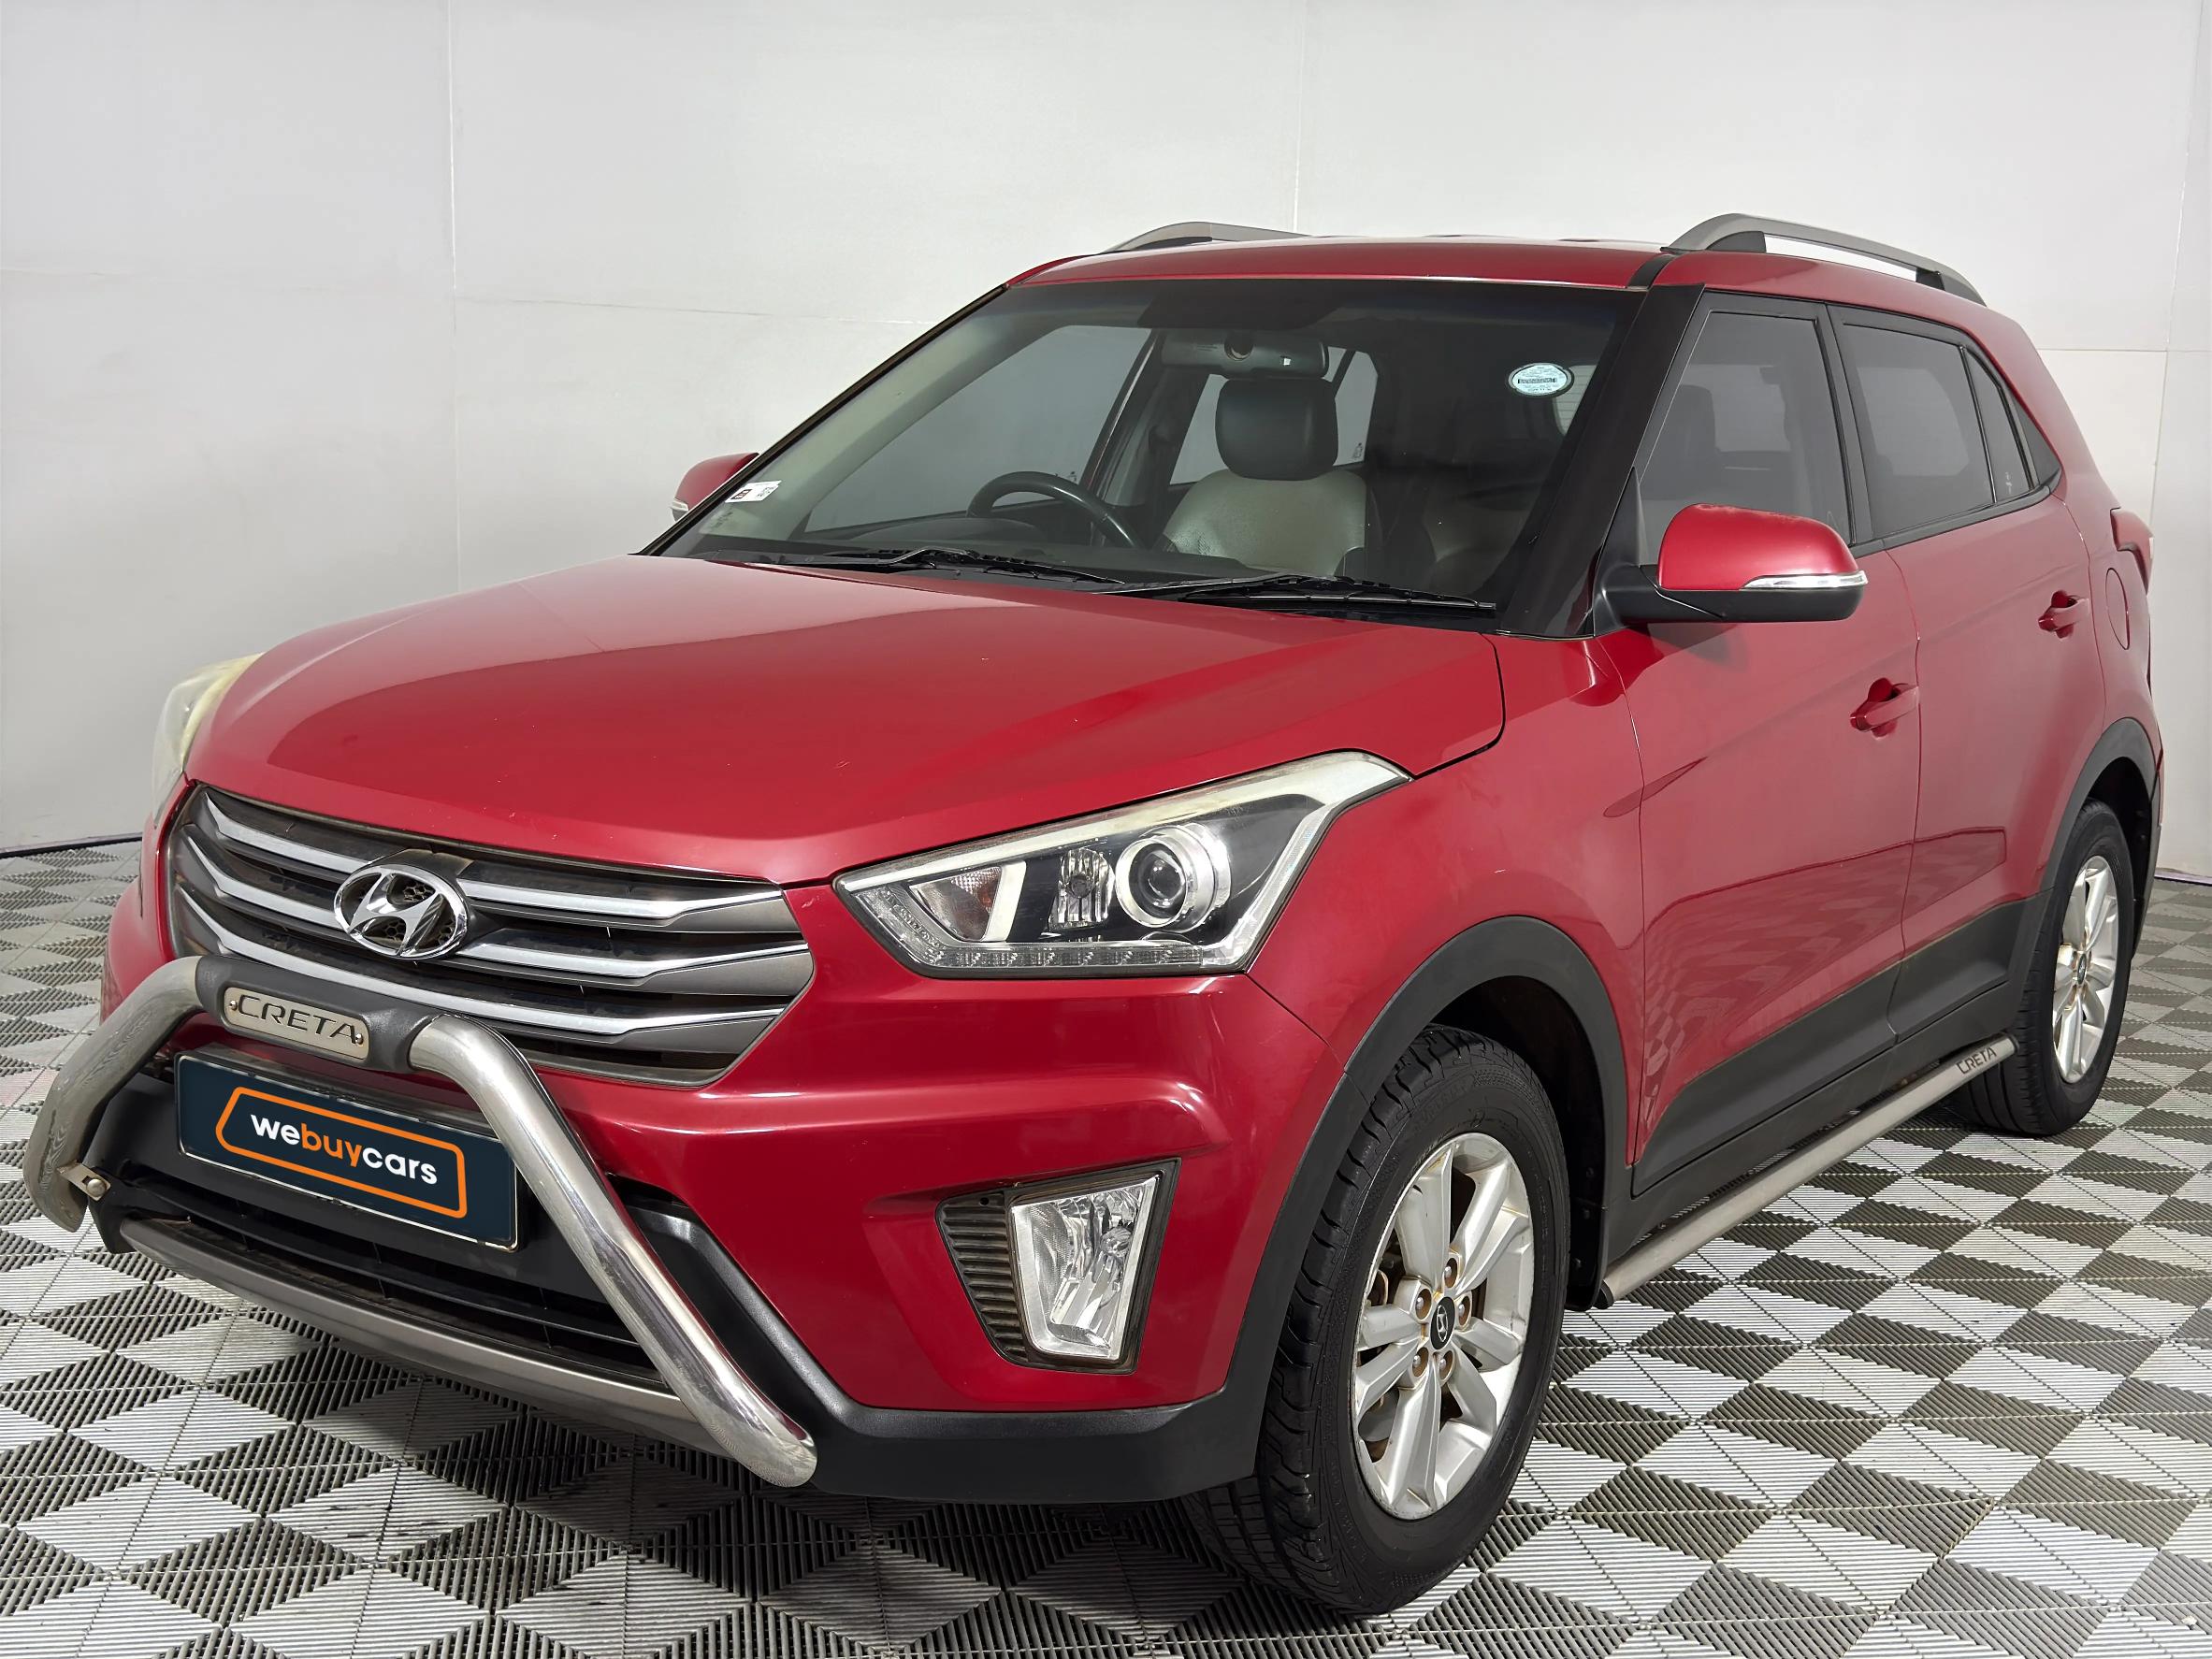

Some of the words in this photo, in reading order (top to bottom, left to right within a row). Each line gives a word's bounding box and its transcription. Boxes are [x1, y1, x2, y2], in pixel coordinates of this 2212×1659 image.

[239, 994, 357, 1045] CRETA
[1956, 1047, 1998, 1075] CRETA
[251, 1114, 438, 1185] webuycars
